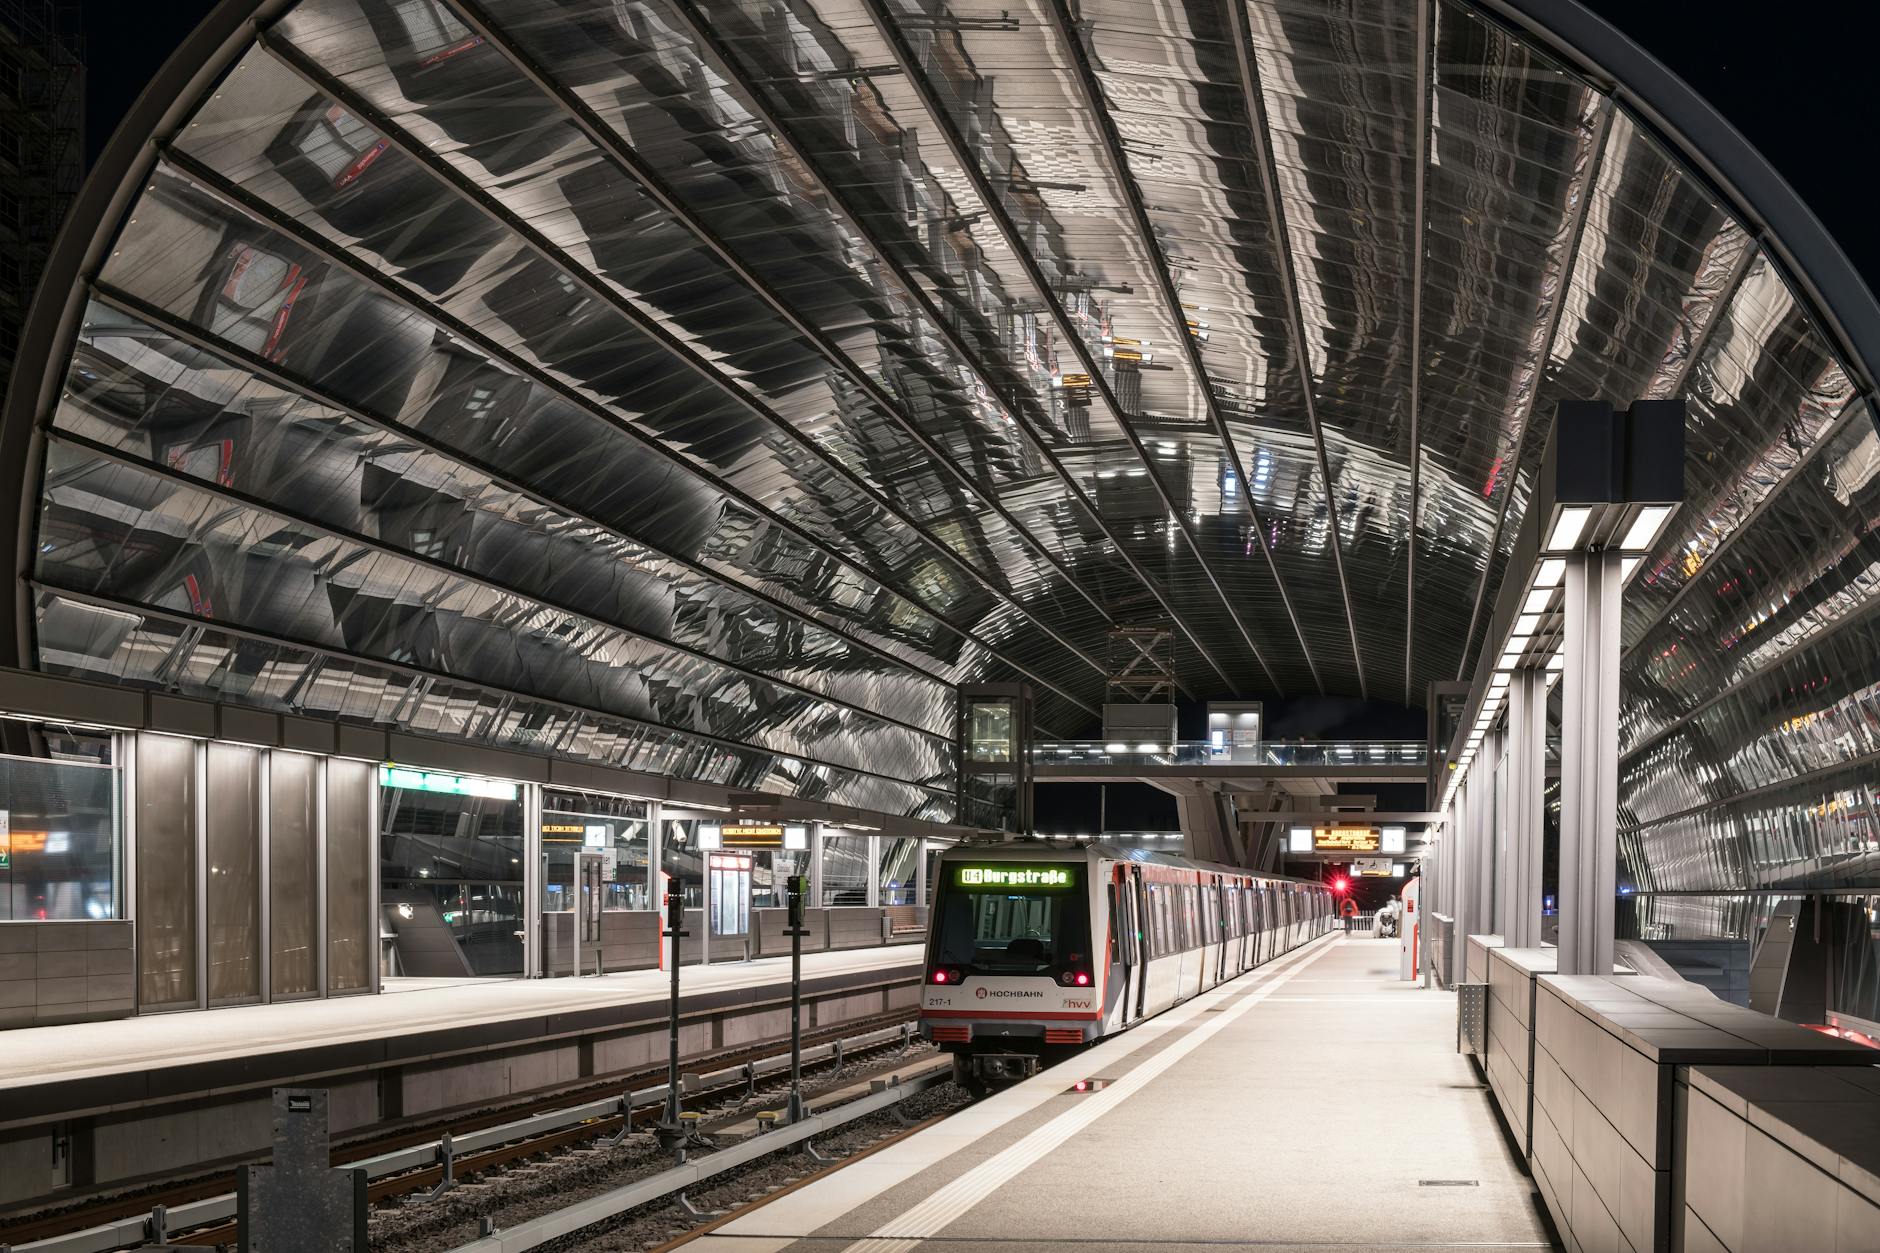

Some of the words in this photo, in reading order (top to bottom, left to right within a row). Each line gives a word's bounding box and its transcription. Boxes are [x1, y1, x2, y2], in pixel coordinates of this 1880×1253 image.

[984, 869, 1067, 884] Burgstraße
[989, 990, 1043, 998] HOCHBAHN
[929, 998, 951, 1006] 217-1
[1068, 999, 1091, 1008] hvv
